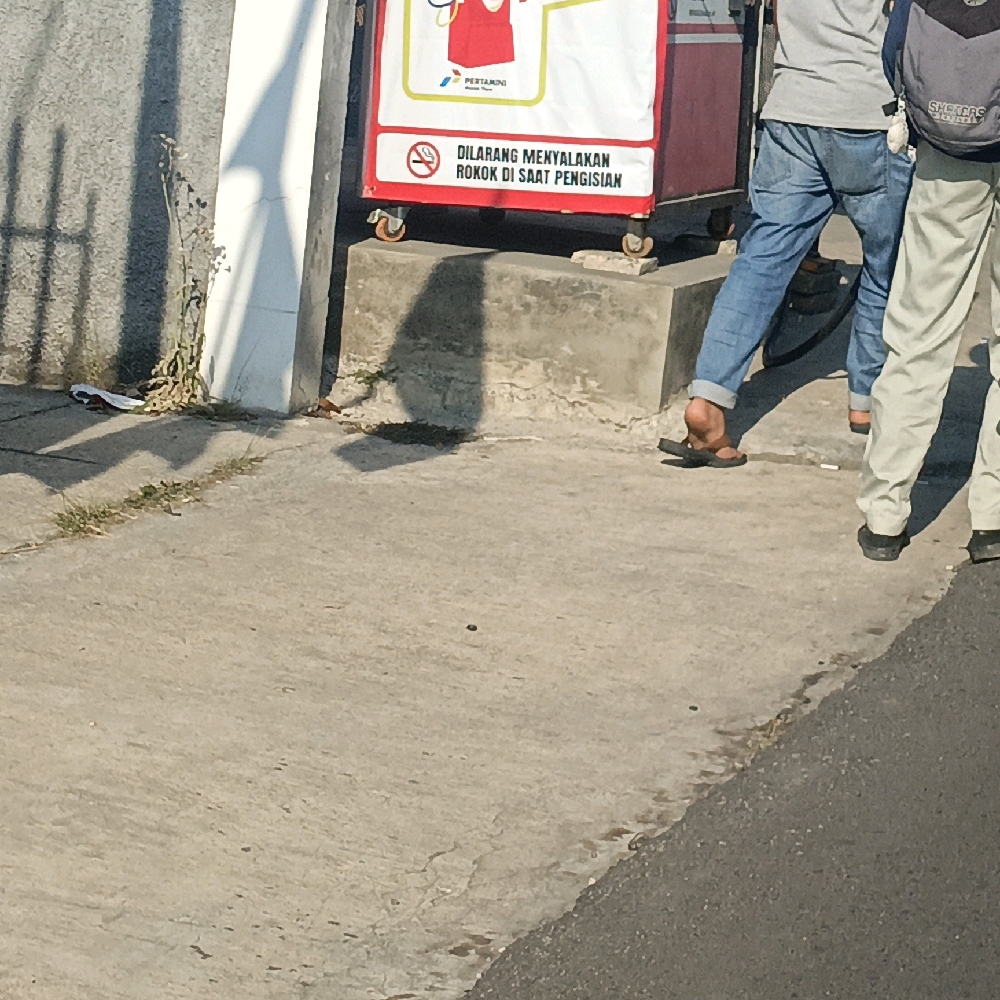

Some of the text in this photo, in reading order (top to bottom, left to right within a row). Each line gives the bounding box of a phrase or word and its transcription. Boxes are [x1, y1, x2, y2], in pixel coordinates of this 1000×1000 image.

[457, 145, 610, 168] DILARANG MENYALAKAN
[456, 164, 622, 188] ROKOK DI SAAT PENGISIAN
